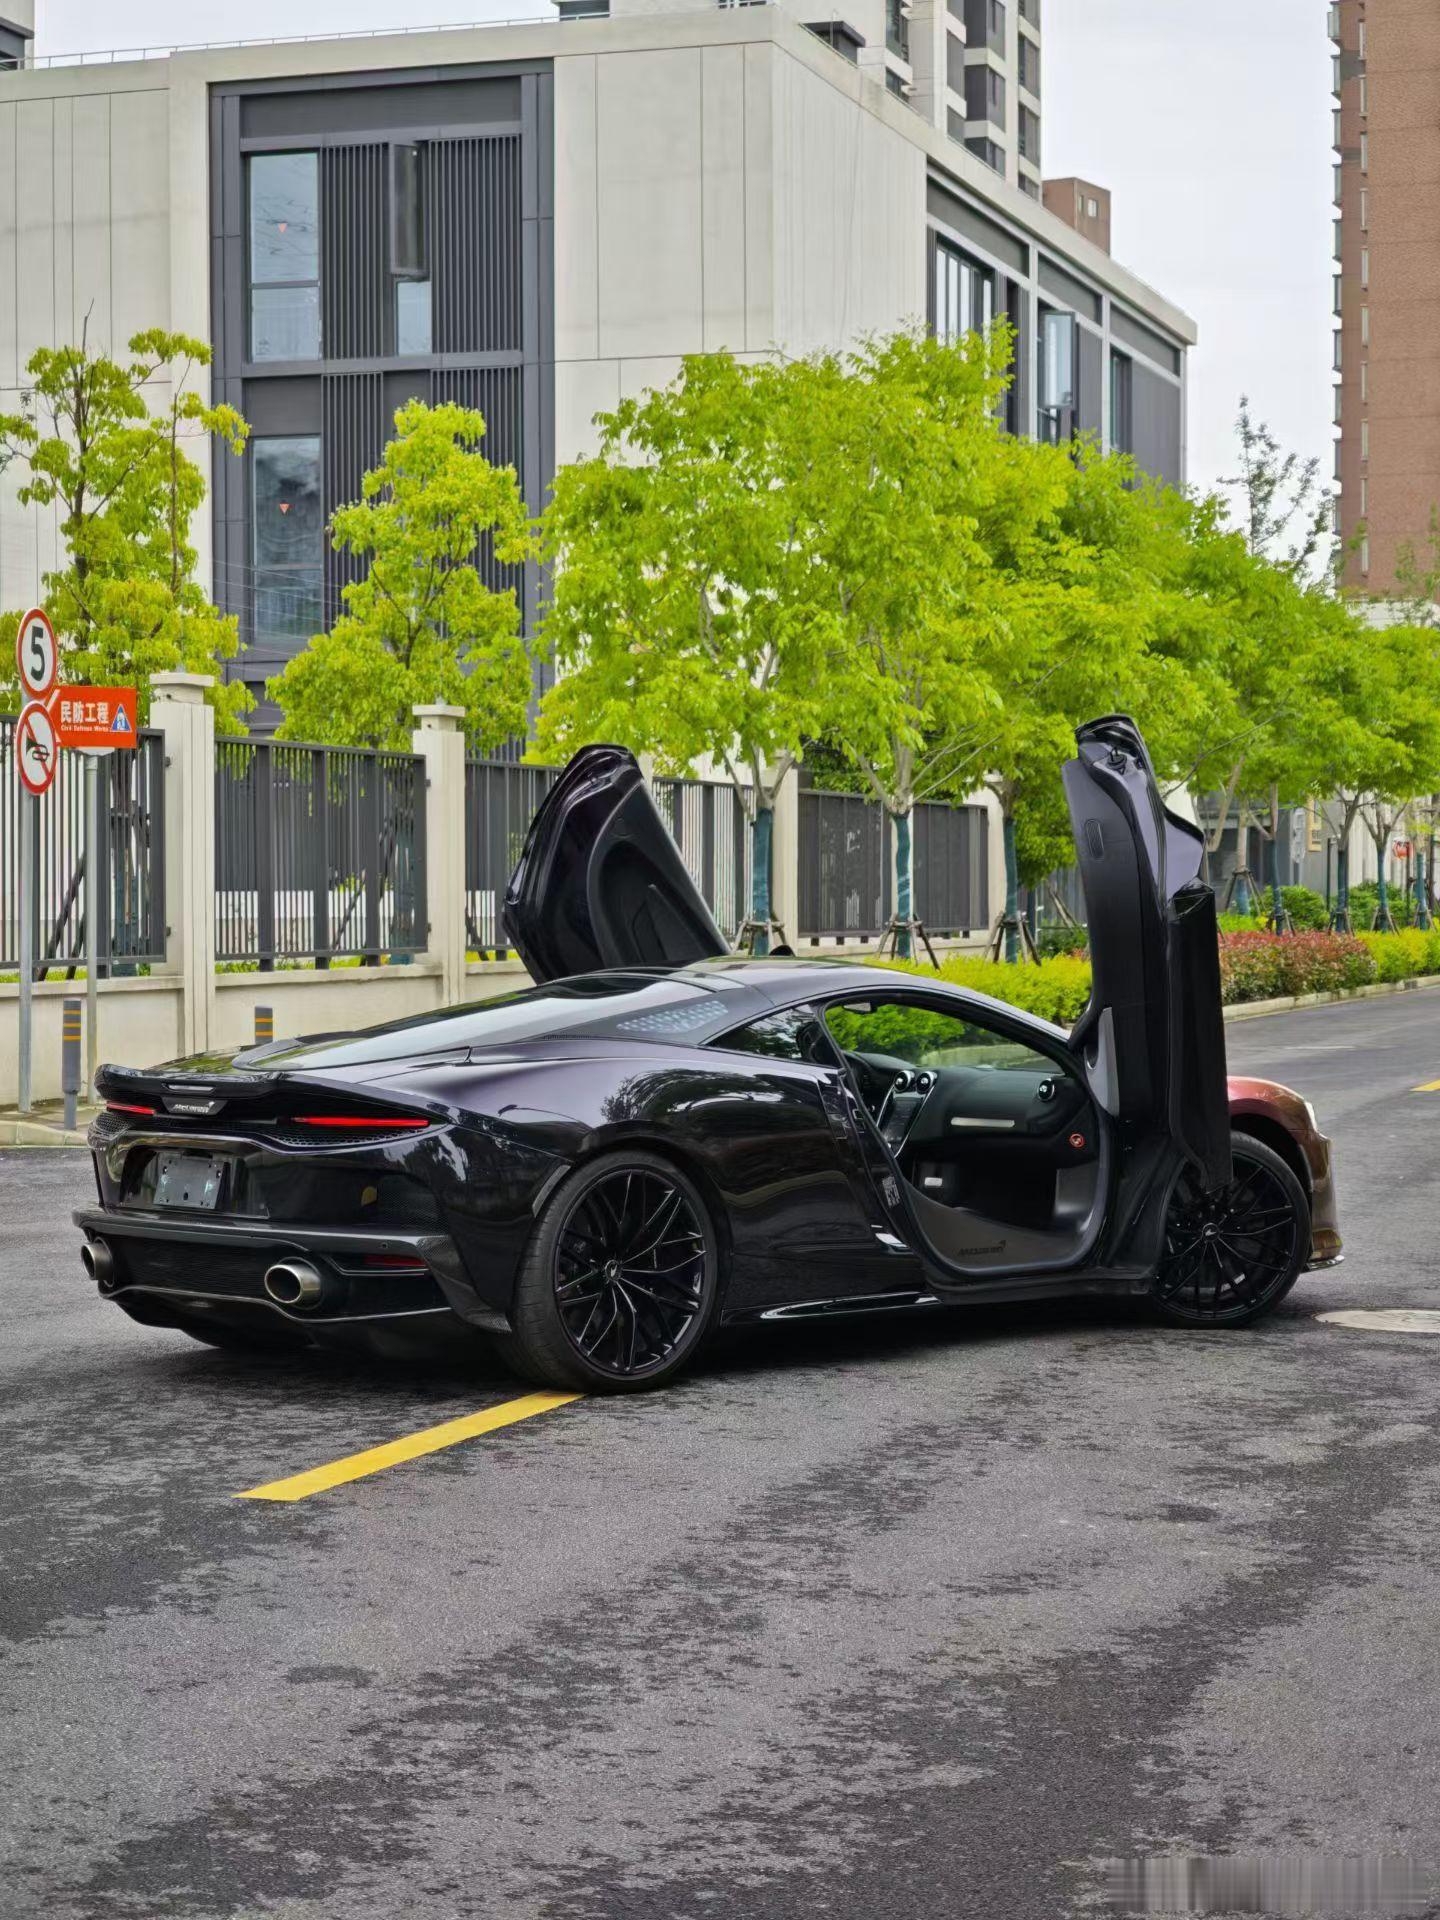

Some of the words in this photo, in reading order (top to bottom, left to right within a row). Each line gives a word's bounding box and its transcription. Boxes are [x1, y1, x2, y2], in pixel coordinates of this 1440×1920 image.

[31, 626, 46, 682] 5
[60, 700, 109, 724] 民防工程
